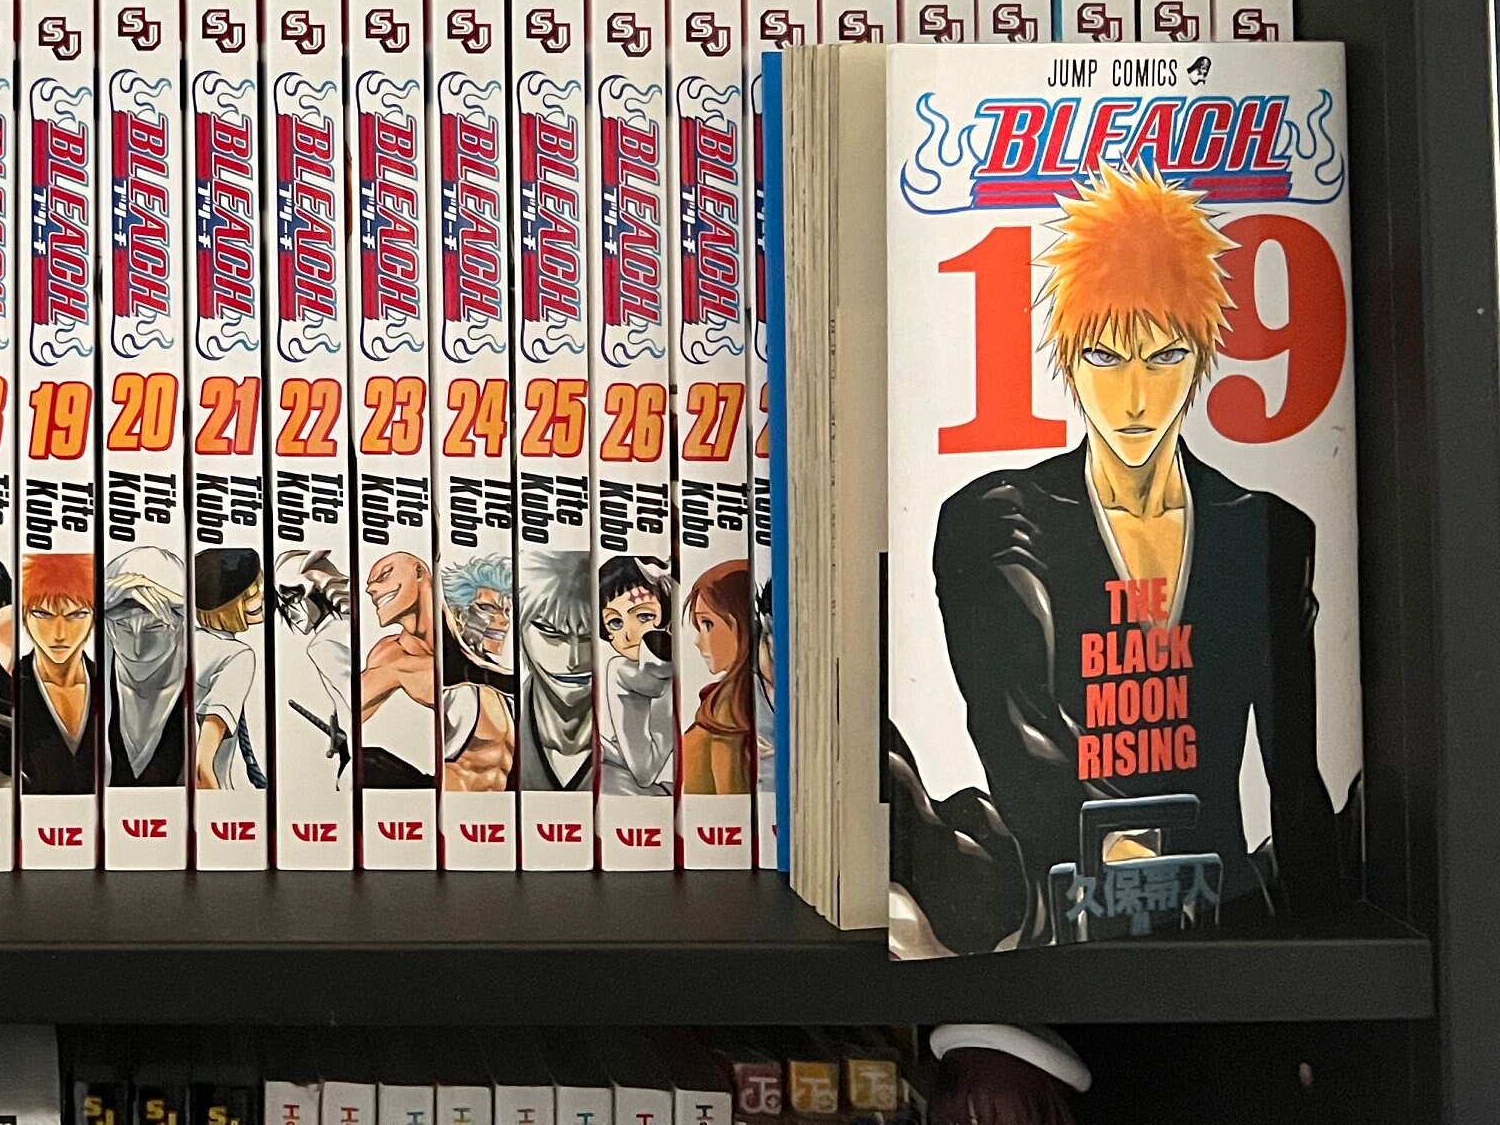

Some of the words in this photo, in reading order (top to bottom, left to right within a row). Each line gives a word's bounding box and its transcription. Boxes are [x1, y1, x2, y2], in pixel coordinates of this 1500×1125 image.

[1048, 60, 1098, 88] JUMP
[1112, 58, 1178, 87] COMICS
[974, 95, 1290, 175] BLEACH
[46, 116, 90, 324] BLEACH
[127, 111, 172, 316] BLEACH
[211, 111, 257, 320] BLEACH
[291, 111, 339, 320] BLEACH
[372, 111, 422, 320] BLEACH
[455, 113, 502, 321] BLEACH
[535, 113, 582, 321] BLEACH
[617, 117, 662, 326] BLEACH
[695, 116, 740, 323] BLEACH
[30, 382, 92, 460] 19
[108, 373, 178, 451] 20
[195, 377, 260, 455] 21
[277, 378, 342, 457] 22
[362, 377, 426, 455] 23
[445, 380, 508, 457] 24
[522, 379, 590, 457] 25
[602, 385, 666, 462] 26
[682, 383, 745, 461] 27
[25, 480, 53, 549] Kubo
[61, 482, 95, 532] Tite
[196, 474, 223, 544] Kubo
[229, 475, 262, 525] Tite
[362, 474, 389, 545] Kubo
[396, 476, 428, 527] Tite
[521, 473, 549, 544] Kubo
[555, 476, 588, 527] Tite
[681, 479, 709, 548] Kubo
[716, 481, 749, 532] Tite
[1105, 577, 1169, 626] THE
[1080, 625, 1194, 678] BLACK
[1085, 676, 1189, 729] MOON
[1077, 724, 1197, 781] RISING
[38, 827, 83, 846] VIZ
[123, 819, 166, 838] VIZ
[211, 821, 255, 840] VIZ
[293, 823, 337, 842] VIZ
[378, 820, 423, 841] VIZ
[461, 825, 504, 843] VIZ
[537, 824, 581, 843] VIZ
[616, 828, 661, 847] VIZ
[698, 827, 742, 845] VIZ
